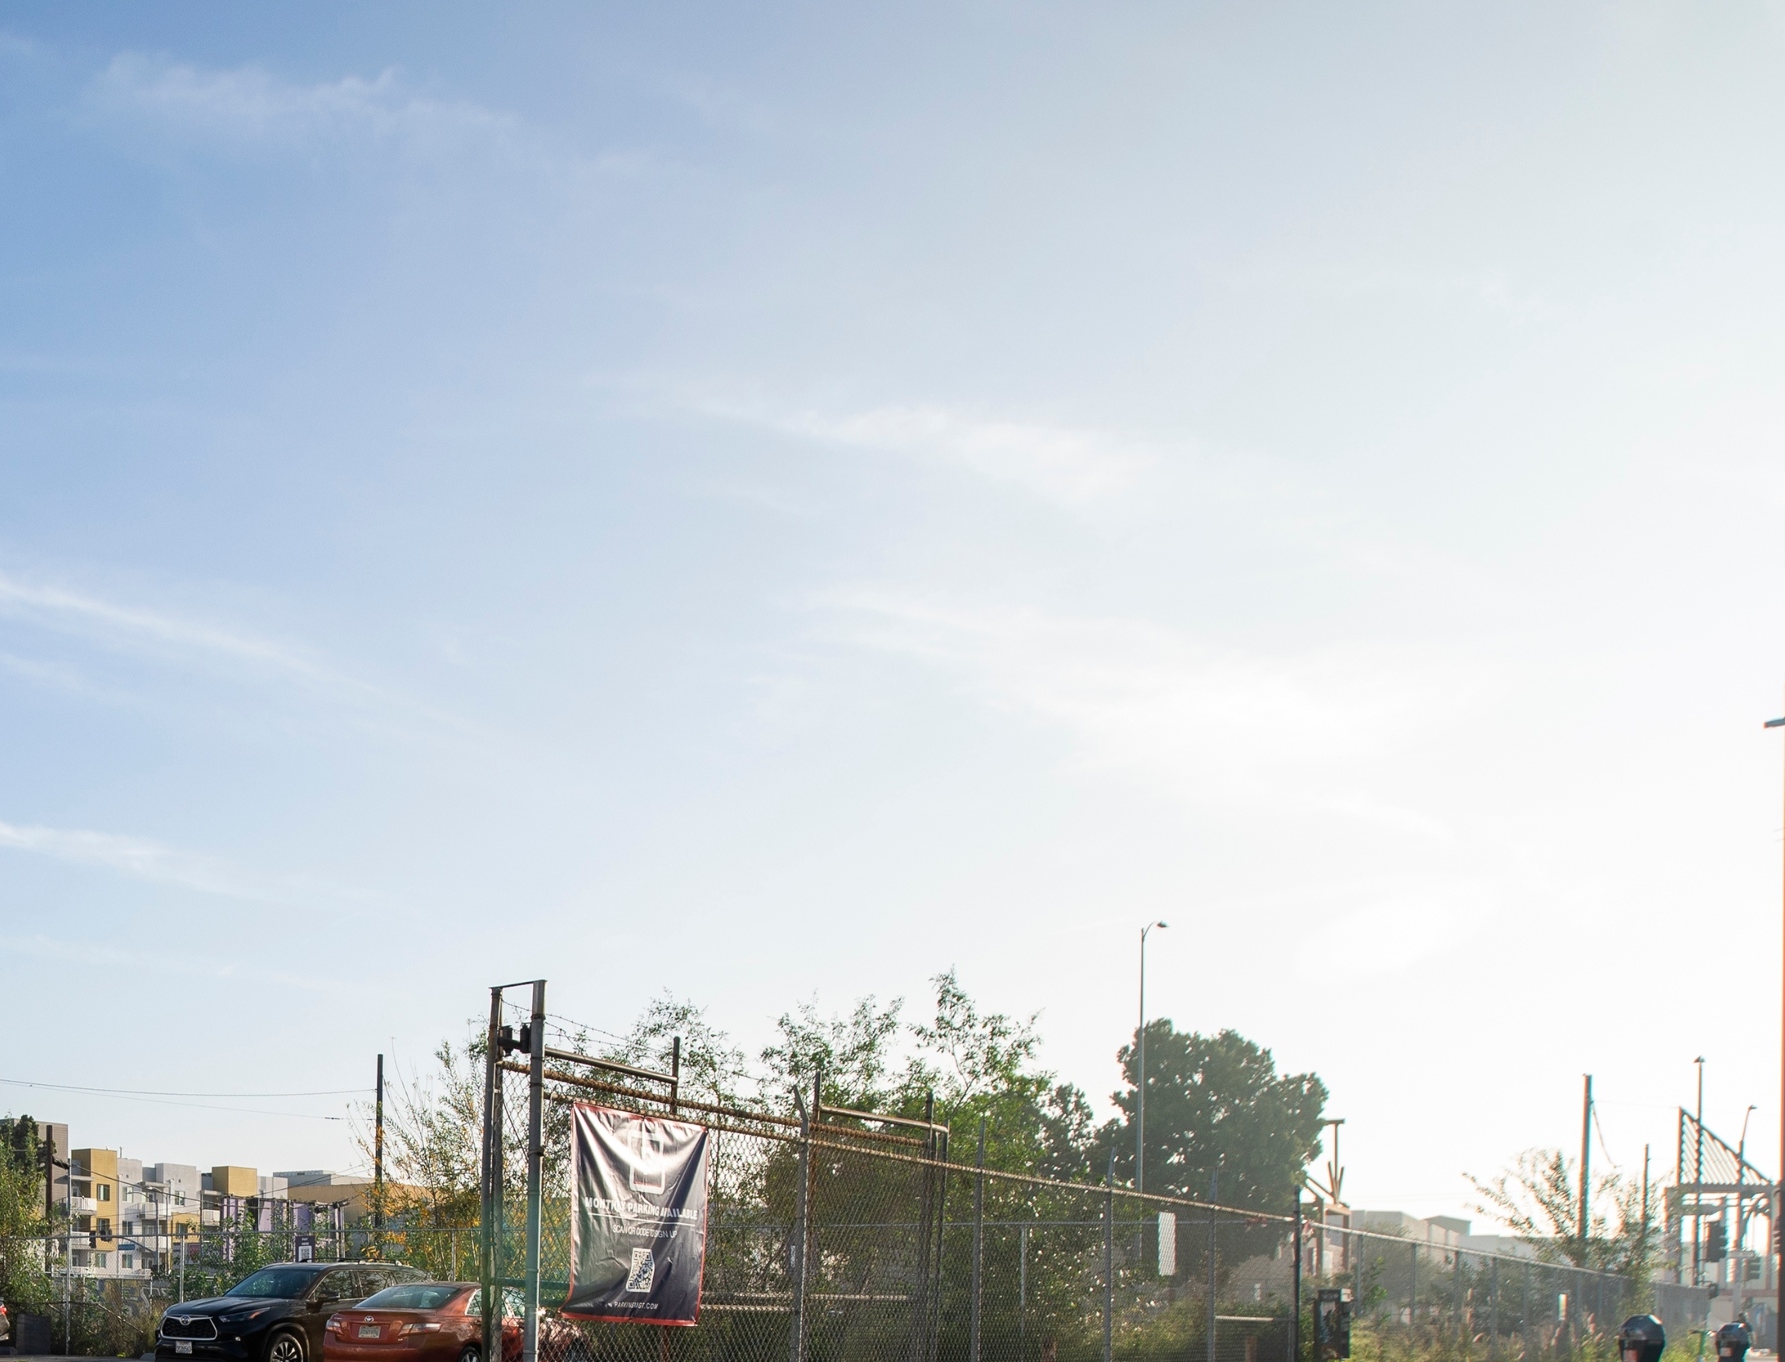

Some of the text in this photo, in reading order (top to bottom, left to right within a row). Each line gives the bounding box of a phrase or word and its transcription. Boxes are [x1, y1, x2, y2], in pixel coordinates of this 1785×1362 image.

[628, 1202, 659, 1216] PARKING
[613, 1224, 628, 1234] SCAN
[669, 1230, 677, 1239] UP
